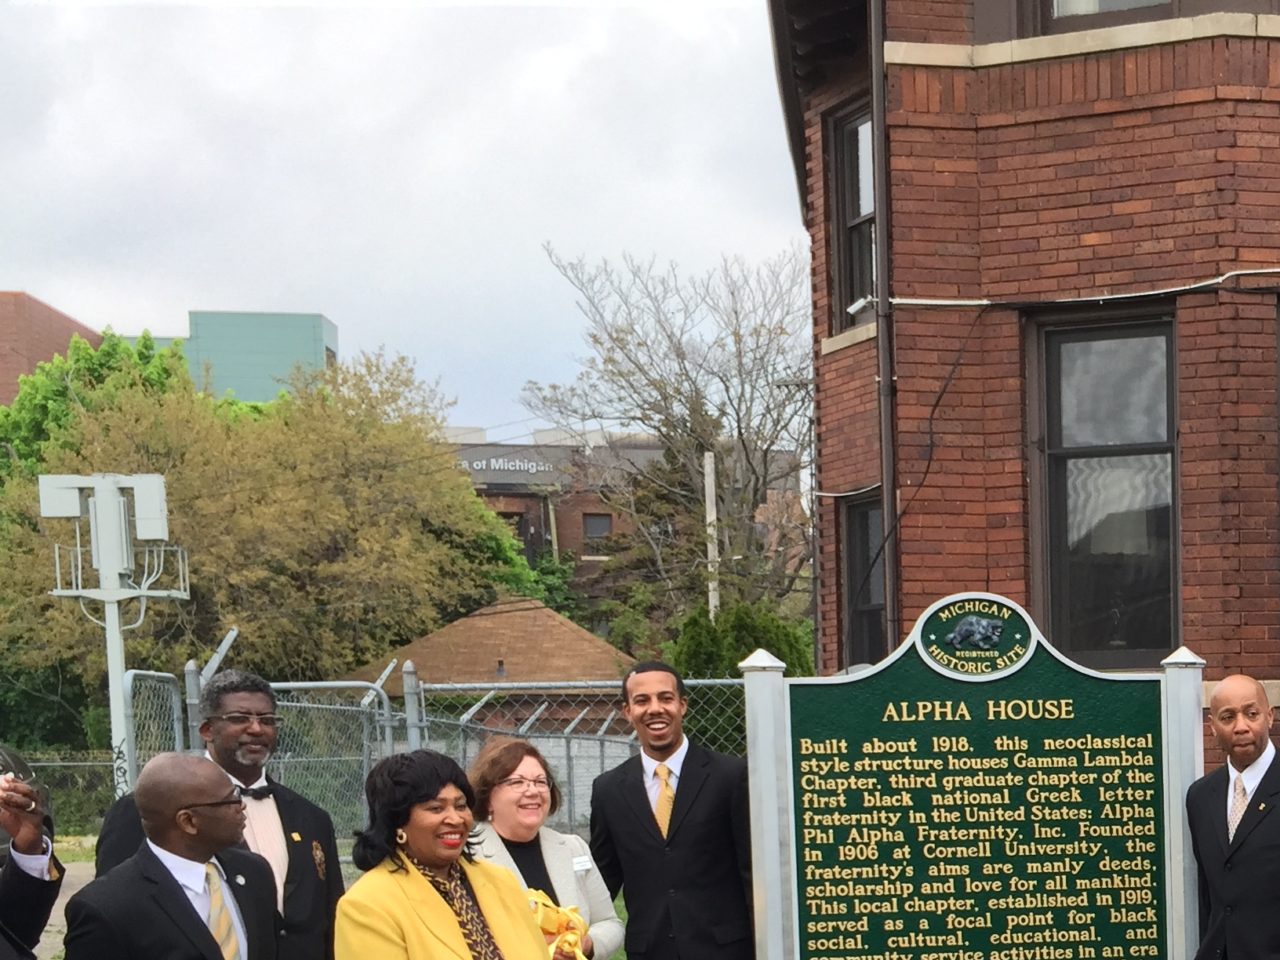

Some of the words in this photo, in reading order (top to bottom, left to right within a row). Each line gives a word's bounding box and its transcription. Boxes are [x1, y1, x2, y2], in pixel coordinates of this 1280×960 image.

[472, 460, 487, 470] of
[490, 458, 554, 473] Michigan
[938, 600, 1012, 622] MICHIGAN
[928, 644, 992, 673] HISTORIC
[996, 644, 1026, 669] SITE
[955, 650, 1000, 658] REGISTERED
[882, 701, 971, 722] ALPHA
[987, 699, 1075, 720] HOUSE
[800, 738, 847, 754] Built
[862, 738, 917, 753] about
[994, 736, 1028, 750] this
[1044, 734, 1152, 750] neoclassical
[801, 757, 850, 775] style
[854, 756, 943, 771] structure
[948, 755, 1008, 770] houses
[1014, 753, 1077, 768] Gamma
[1084, 751, 1153, 766] Lambda
[889, 773, 937, 788] third
[942, 772, 1023, 791] graduate
[1028, 771, 1097, 788] chapter
[1102, 769, 1122, 783] of
[1126, 769, 1154, 783] the
[802, 792, 846, 808] first
[863, 791, 913, 807] black
[932, 789, 1010, 805] national
[1026, 787, 1082, 803] Greek
[1099, 787, 1154, 801] letter
[803, 810, 901, 826] fraternity
[909, 810, 927, 823] in
[931, 808, 960, 822] the
[965, 806, 1025, 822] United
[1031, 805, 1092, 820] States:
[1101, 804, 1154, 821] Alpha
[803, 829, 833, 844] Phi
[847, 827, 904, 845] Alpha
[1034, 823, 1065, 838] Inc.
[1079, 821, 1155, 837] Founded
[804, 848, 822, 861] in
[839, 844, 878, 860] 1906
[893, 845, 911, 859] at
[923, 842, 991, 858] Cornell
[1126, 838, 1155, 852] the
[805, 861, 913, 880] fraternity's
[928, 862, 969, 876] aims
[983, 864, 1013, 874] are
[1027, 858, 1084, 874] manly
[806, 880, 913, 897] scholarship
[921, 878, 955, 894] and
[965, 878, 1002, 892] love
[1009, 877, 1037, 891] for
[1045, 875, 1067, 890] all
[1076, 873, 1155, 889] mankind.
[806, 900, 847, 915] This
[854, 898, 898, 913] local
[988, 892, 1088, 909] established
[1096, 893, 1112, 905] in
[808, 916, 868, 932] served
[884, 920, 903, 930] as
[919, 919, 929, 929] a
[946, 913, 992, 929] focal
[1007, 911, 1053, 929] point
[1068, 910, 1095, 924] for
[1110, 907, 1157, 922] black
[1126, 925, 1157, 939] and
[990, 946, 1073, 960] activities
[1079, 945, 1095, 958] in
[1102, 947, 1123, 957] an
[1130, 946, 1158, 956] era
